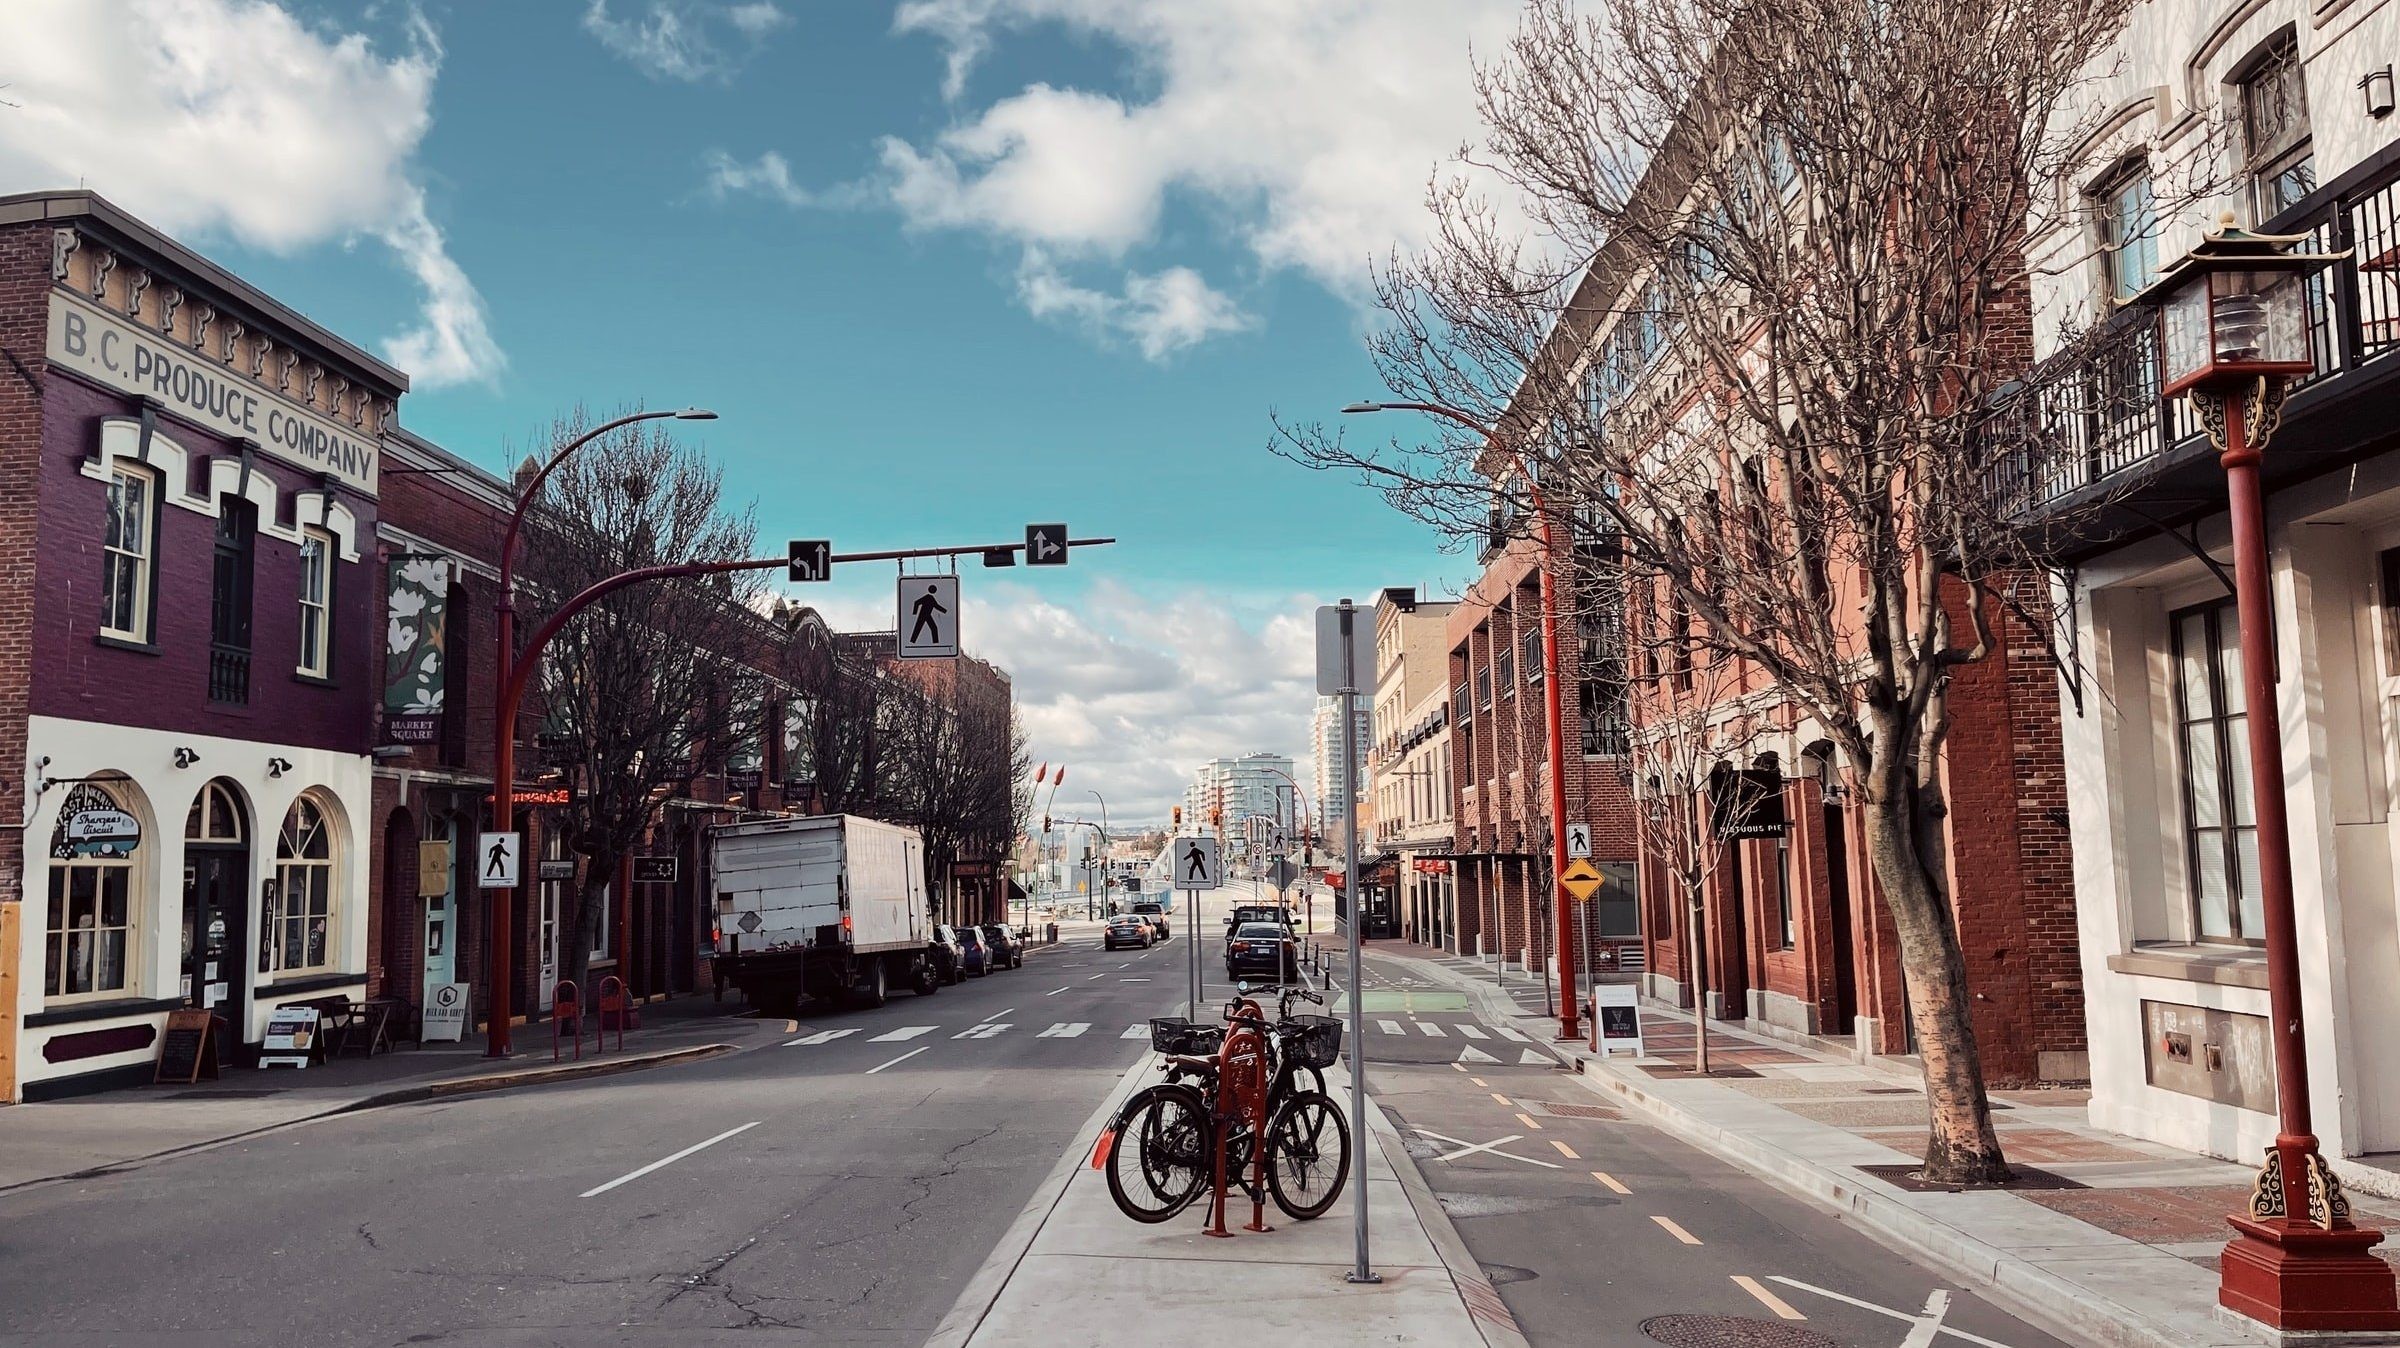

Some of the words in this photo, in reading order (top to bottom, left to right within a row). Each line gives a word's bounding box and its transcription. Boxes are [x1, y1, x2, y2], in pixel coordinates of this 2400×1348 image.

[64, 310, 129, 379] B.C.
[134, 343, 258, 434] PRODUCE
[268, 409, 372, 481] COMPANY
[391, 721, 434, 730] MARKET
[391, 730, 434, 741] SQUARE
[82, 824, 114, 835] Biscuit
[1719, 825, 1764, 833] VRTUOUS
[263, 883, 274, 953] PATIO
